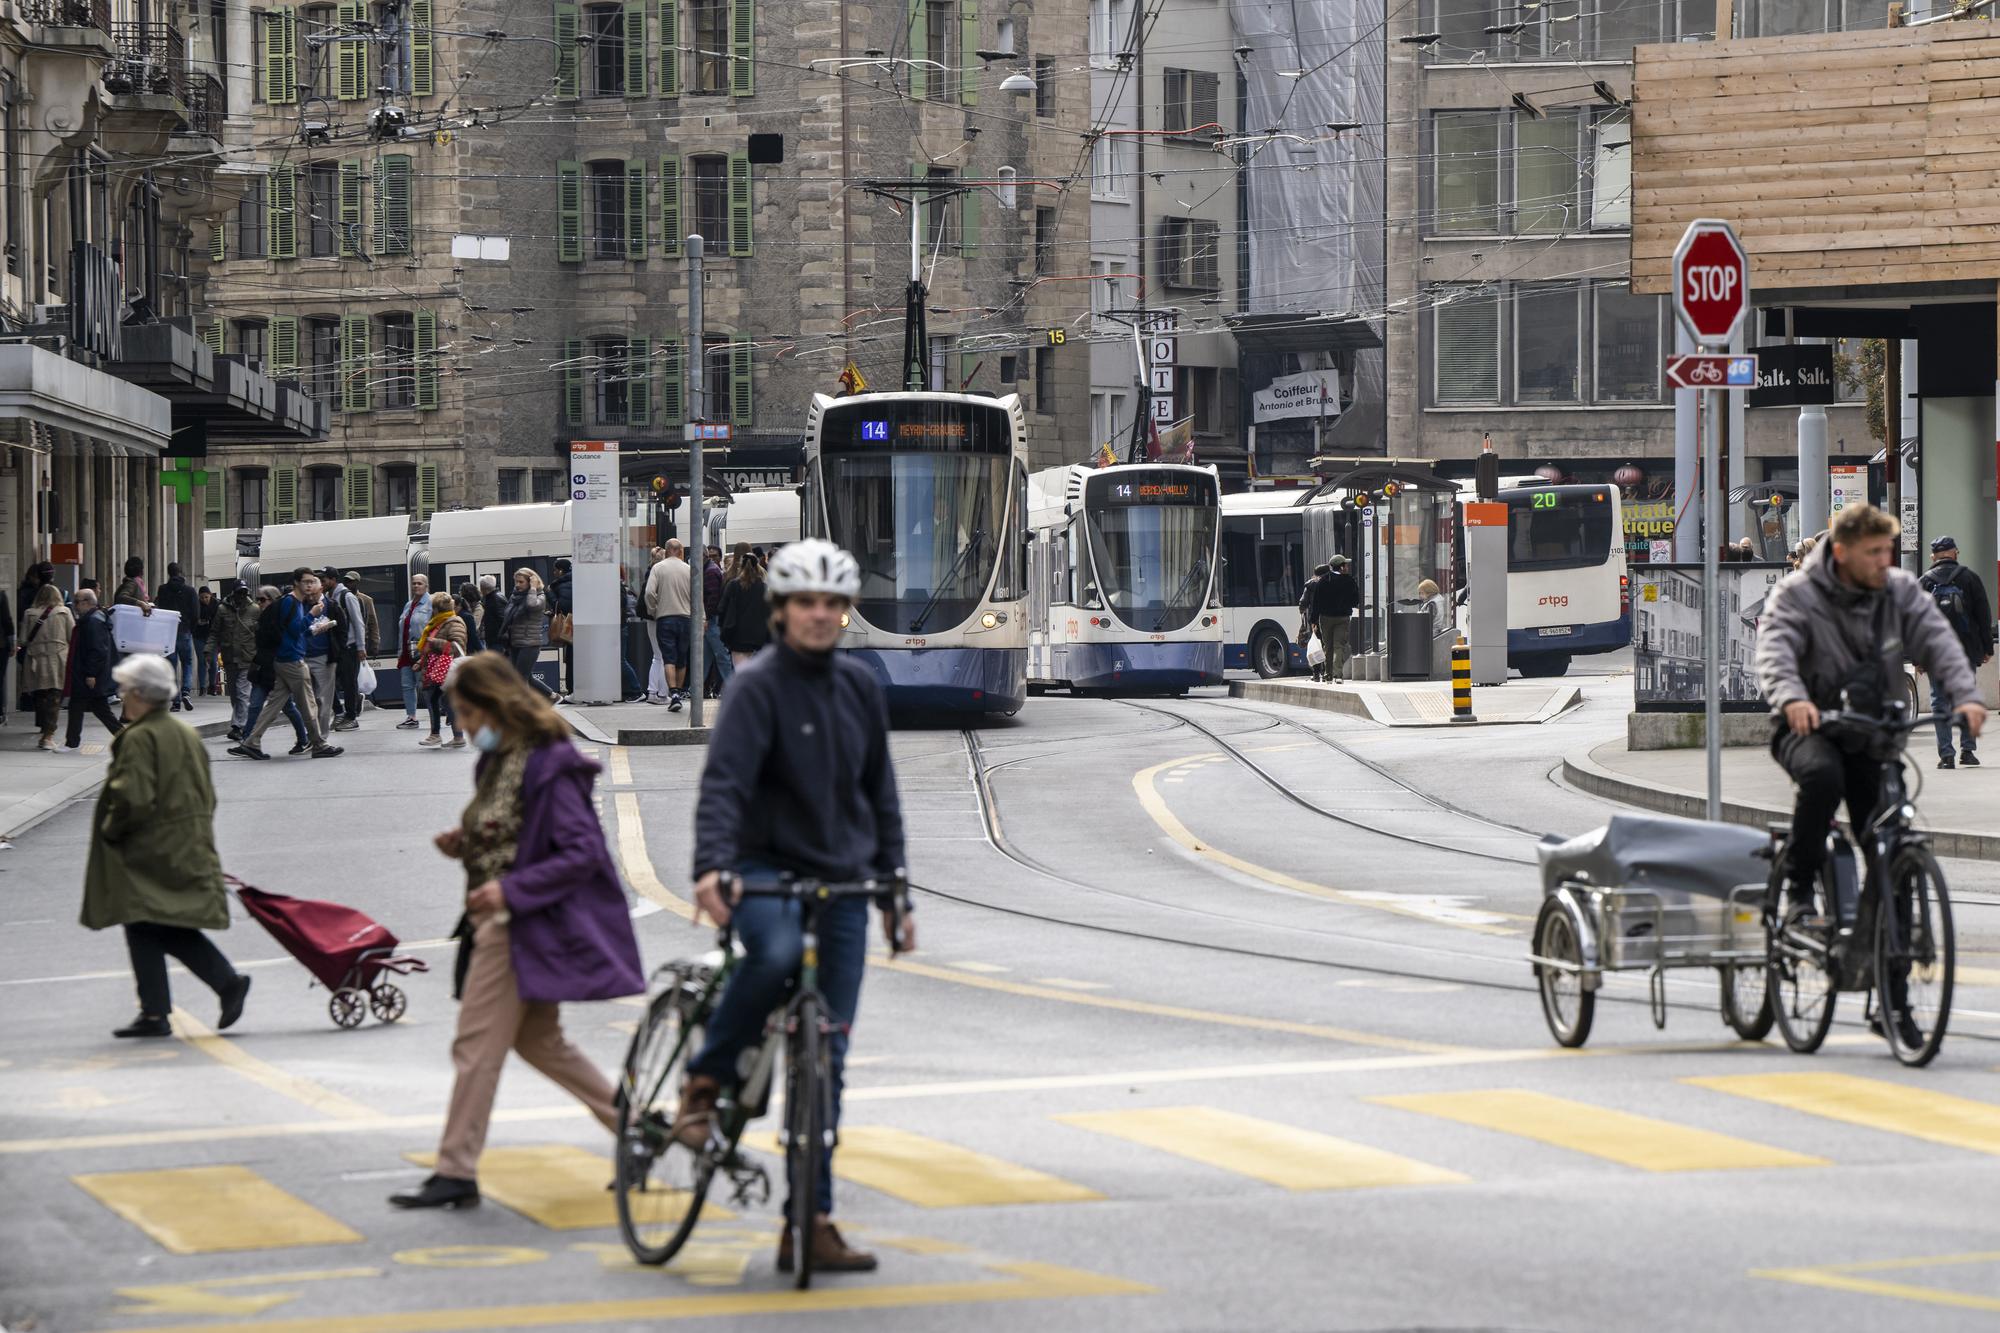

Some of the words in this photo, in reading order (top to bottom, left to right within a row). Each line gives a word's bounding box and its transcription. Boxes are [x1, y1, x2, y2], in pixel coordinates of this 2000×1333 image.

[1687, 265, 1737, 302] STOP
[1048, 329, 1065, 344] 15
[1727, 360, 1750, 377] 46
[1797, 367, 1830, 386] Salt.
[1274, 385, 1318, 399] Coiffeur
[1259, 401, 1294, 411] Antonio
[1295, 399, 1304, 407] et
[864, 421, 886, 439] 14
[723, 472, 791, 491] HOMME
[1116, 484, 1131, 497] 14
[1533, 493, 1556, 508] 20
[1623, 519, 1674, 538] tique
